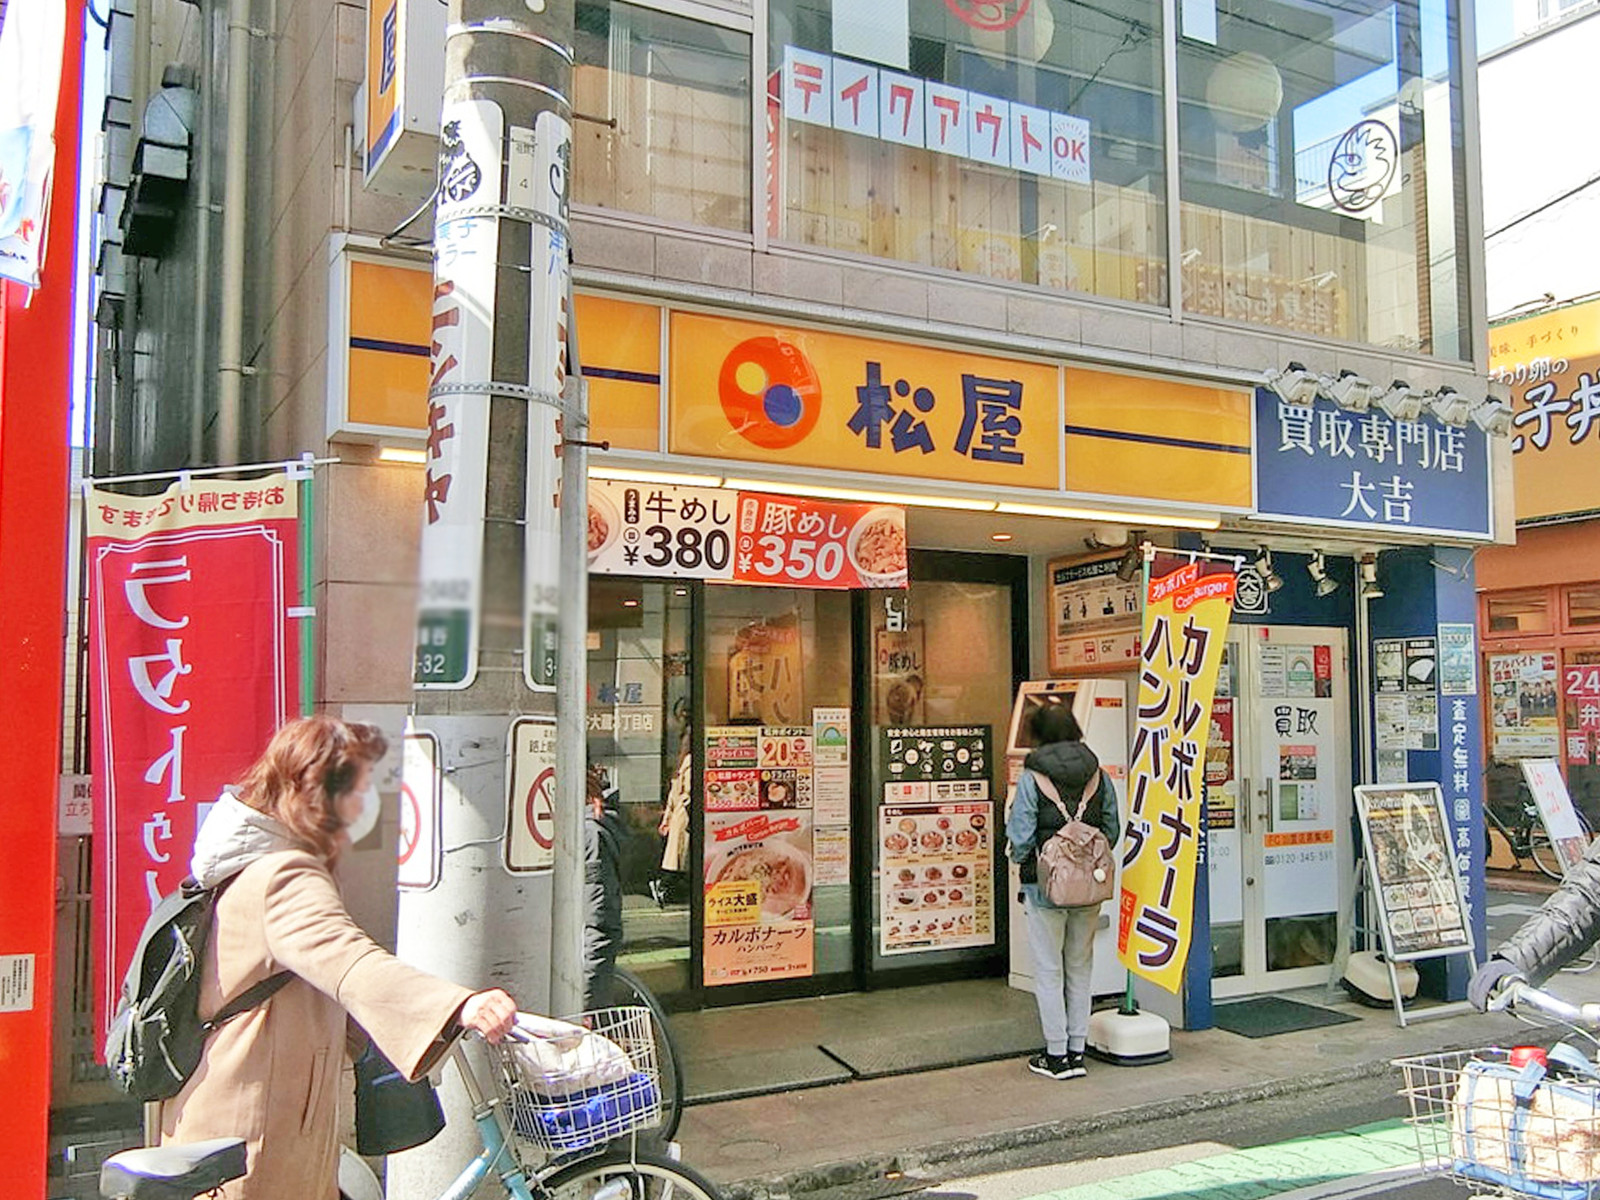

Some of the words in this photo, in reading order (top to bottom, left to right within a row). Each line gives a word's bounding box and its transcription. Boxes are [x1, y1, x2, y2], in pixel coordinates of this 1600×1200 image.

[846, 361, 1025, 465] 松屋
[1278, 401, 1467, 473] 買取専門店
[644, 490, 732, 526] 牛めし
[1339, 470, 1415, 523] 大吉
[760, 501, 848, 540] 豚めし
[1566, 670, 1600, 696] 24
[1121, 617, 1173, 871] ハンバーグ
[1274, 705, 1320, 738] 買取
[1136, 614, 1210, 970] カルボナーラ
[711, 924, 808, 947] カルボナーラ
